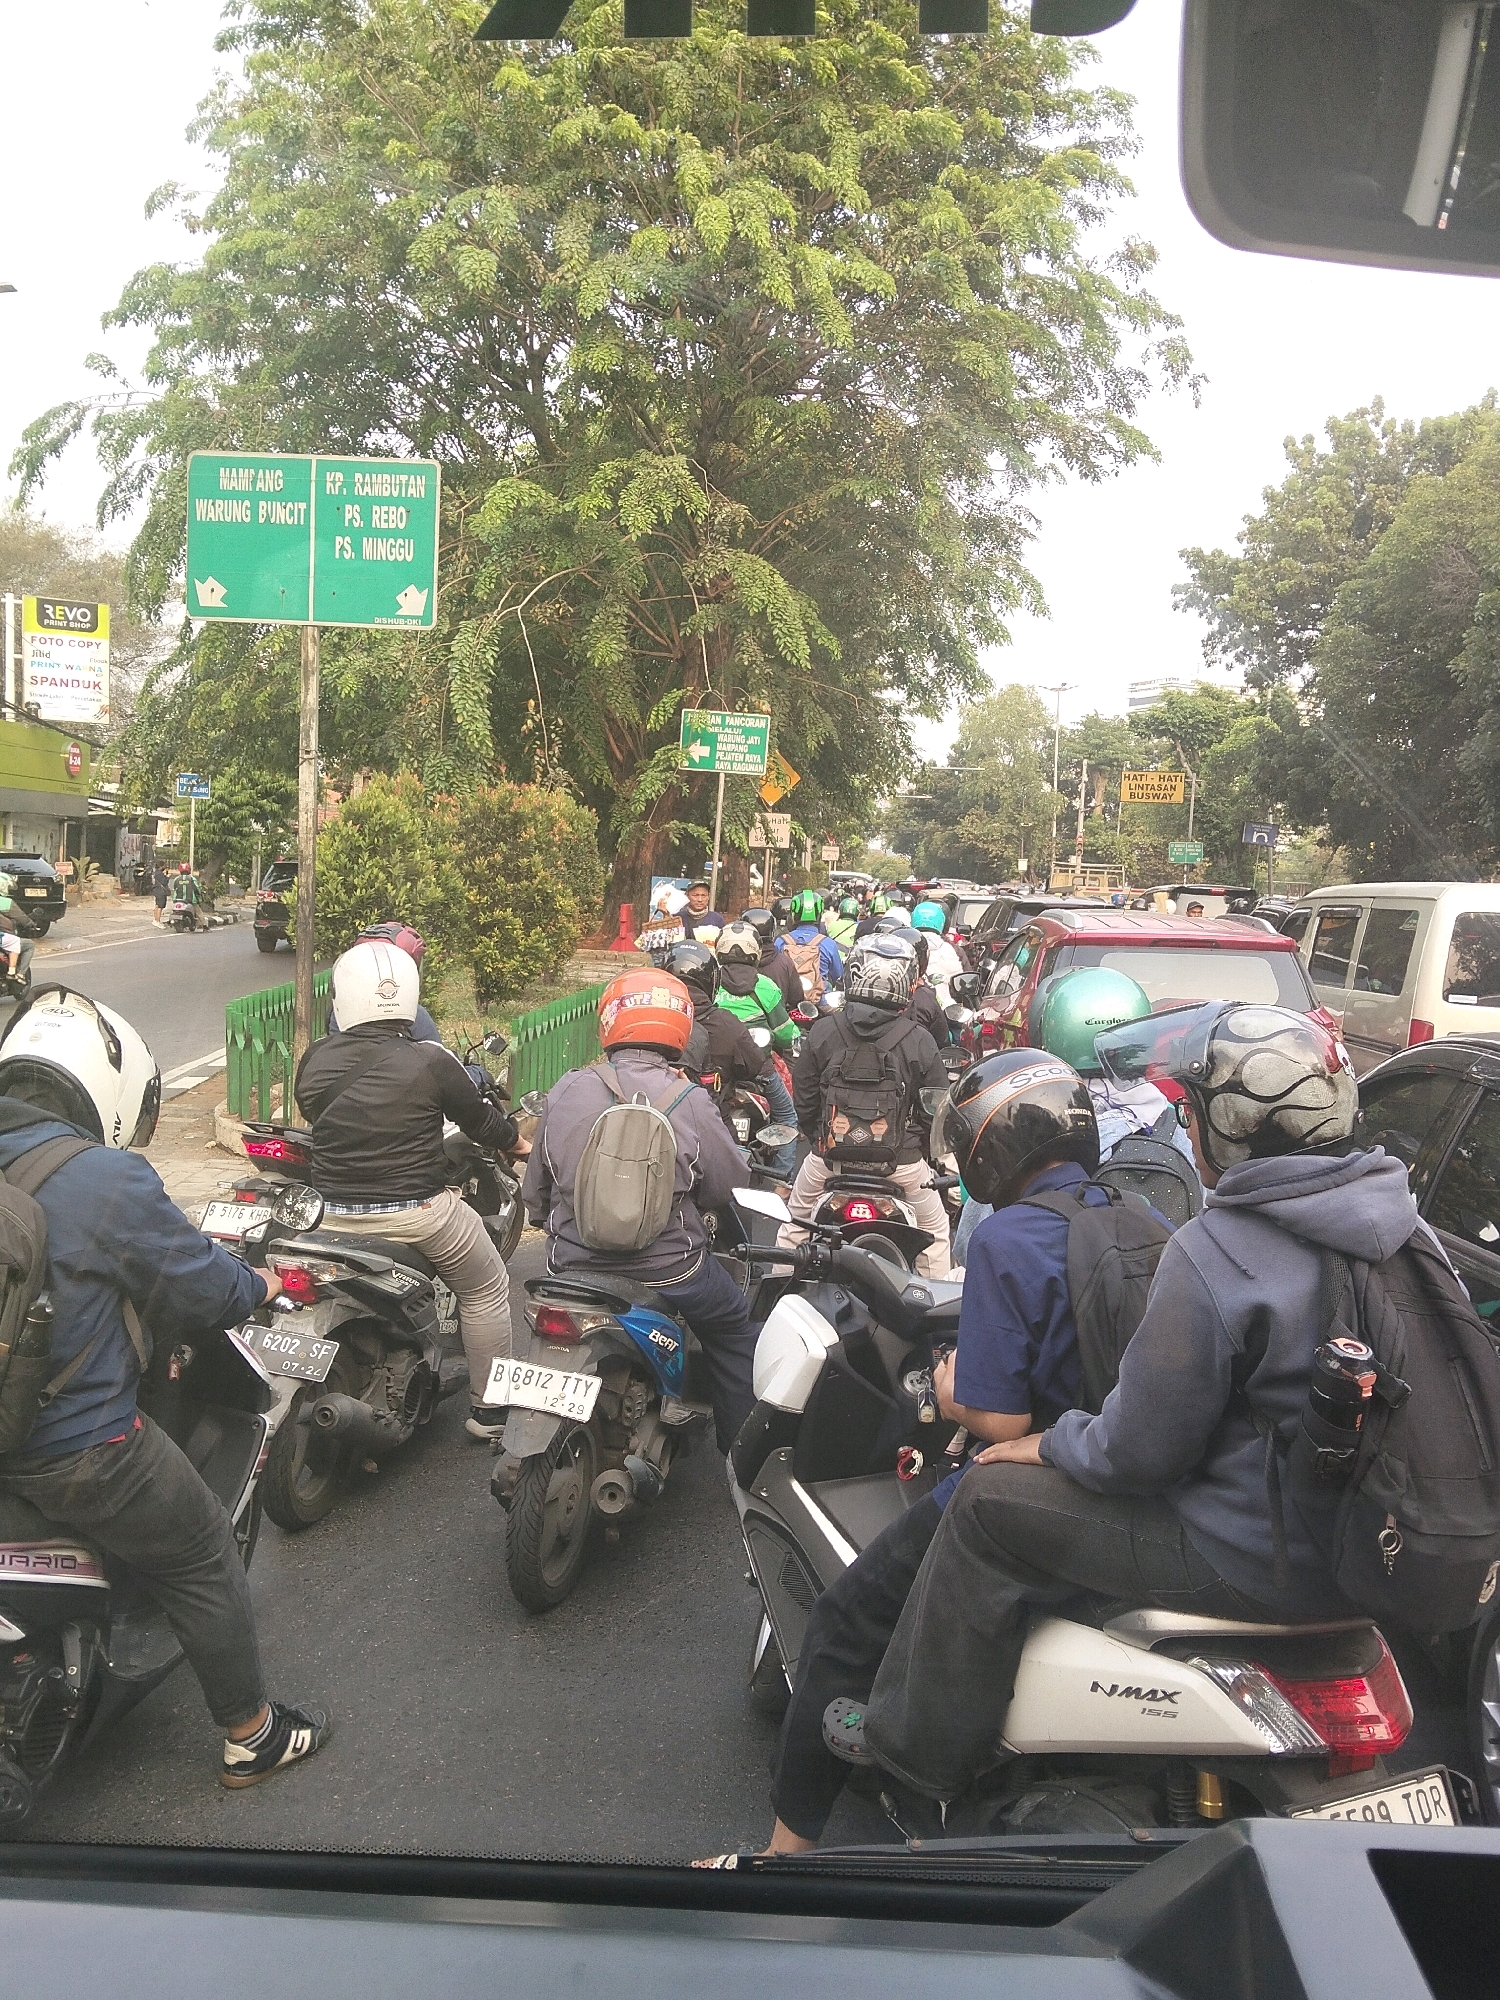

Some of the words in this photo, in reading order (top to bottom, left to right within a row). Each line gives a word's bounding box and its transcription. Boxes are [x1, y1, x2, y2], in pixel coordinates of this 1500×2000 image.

[326, 472, 347, 495] KP.
[354, 473, 426, 498] RAMBUTAN
[195, 499, 251, 523] WARUNG
[345, 505, 364, 528] PS.
[372, 506, 406, 529] REBO
[335, 536, 355, 559] PS.
[362, 537, 414, 562] MINGGU
[44, 604, 91, 622] REVO
[44, 619, 67, 627] PRINT
[69, 621, 91, 629] SHOP
[31, 636, 63, 646] FOTO
[69, 640, 102, 649] COPY
[32, 650, 50, 658] Jilid
[31, 661, 61, 669] PRINT
[30, 675, 102, 690] SPANDUK
[725, 716, 766, 728] PANCORAN
[717, 733, 745, 743] WARUNG
[746, 736, 761, 745] JATI
[716, 743, 748, 753] MAMPANG
[716, 751, 744, 762] PEJATEN
[744, 754, 761, 763] RAYA
[715, 761, 732, 770] RAYA
[732, 763, 764, 773] RAGUNAN
[1123, 773, 1148, 781] HATI
[1158, 774, 1183, 783] HATI
[1128, 783, 1177, 792] LINTASAN
[1129, 792, 1175, 800] BUSWAY
[1064, 1107, 1093, 1117] HONDA
[208, 1203, 216, 1217] B
[220, 1206, 246, 1219] 5176
[262, 1333, 301, 1355] 6202
[309, 1343, 332, 1360] SF
[493, 1363, 506, 1382] B
[511, 1366, 554, 1390] 6812
[562, 1375, 594, 1398] TTY
[1090, 1681, 1182, 1704] NMAX
[1141, 1707, 1179, 1719] 155
[1401, 1785, 1447, 1824] TDR
